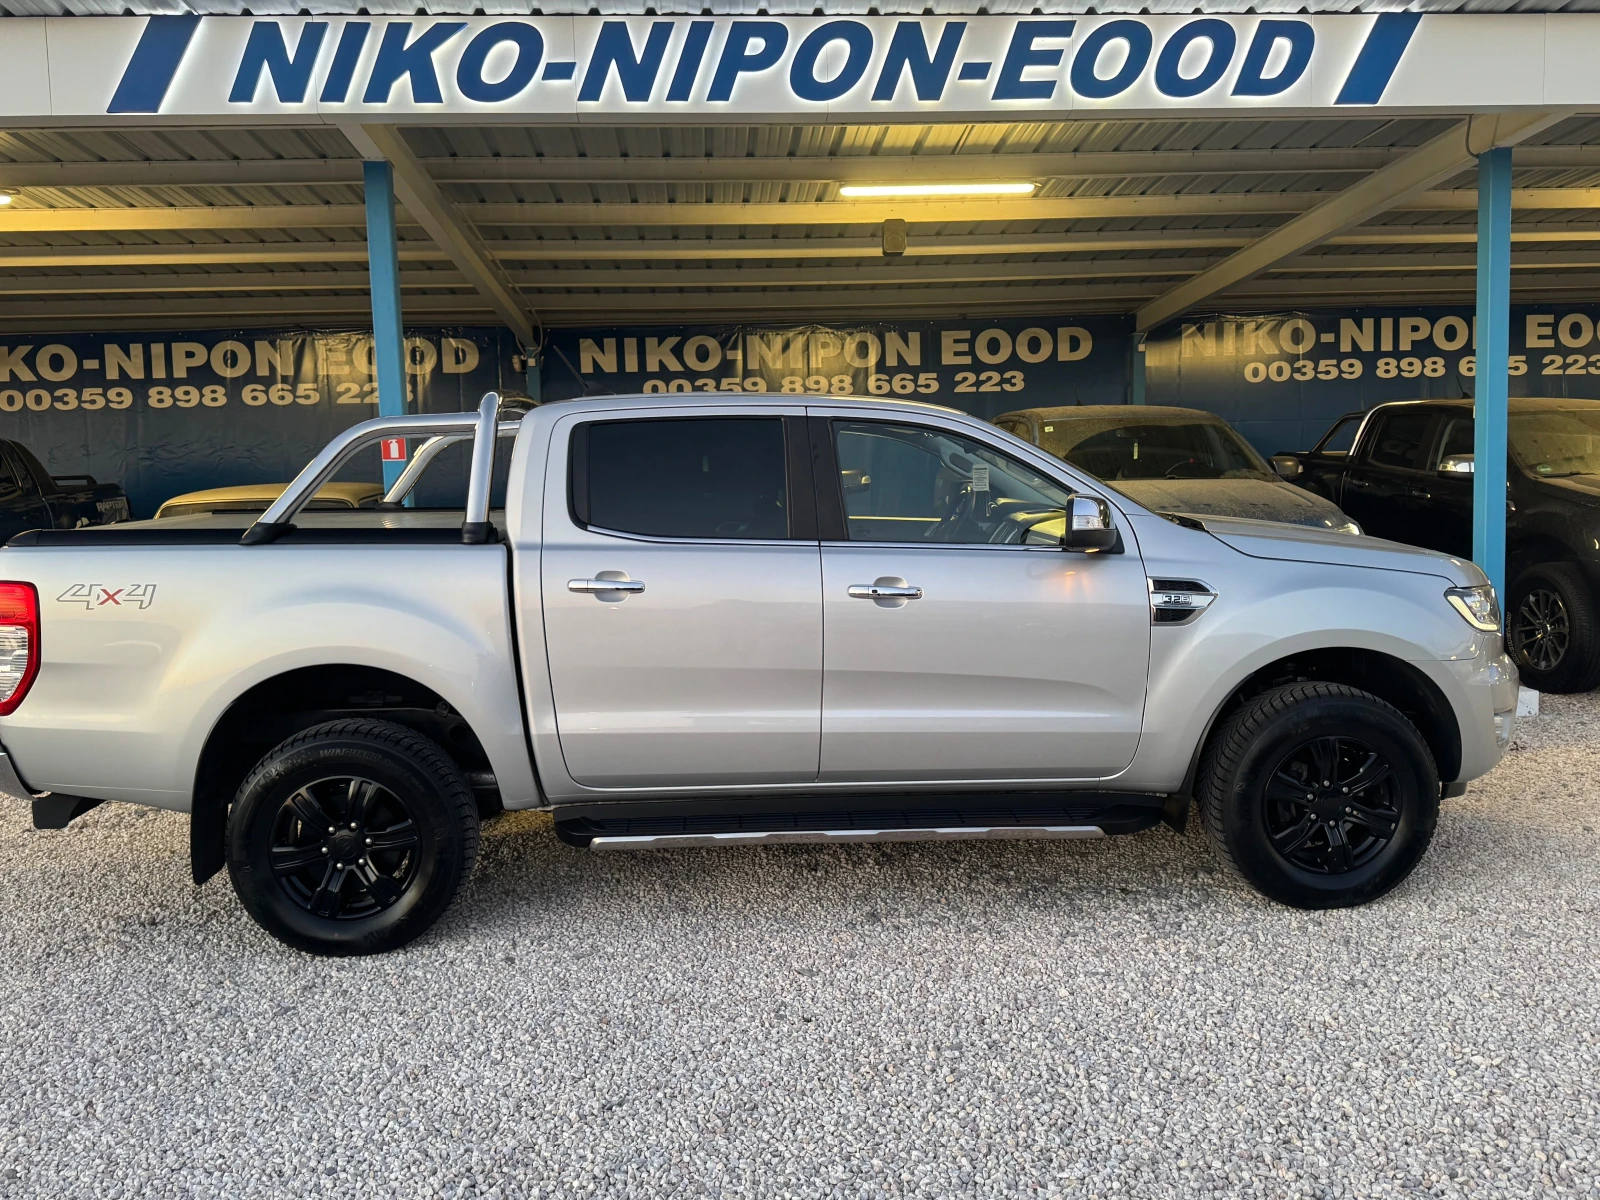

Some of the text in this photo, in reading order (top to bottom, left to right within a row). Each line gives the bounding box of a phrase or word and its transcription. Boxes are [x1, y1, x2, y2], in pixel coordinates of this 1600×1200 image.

[228, 18, 1315, 104] NIKO-NIPON-EOOD
[579, 327, 1093, 374] NIKO-NIPON EOOD
[1181, 313, 1600, 358] NIKO-NIPO EO
[781, 375, 854, 395] 898
[867, 373, 939, 394] 665
[954, 371, 1025, 393] 223
[1244, 358, 1363, 383] 00359
[1375, 356, 1446, 379] 898
[1458, 355, 1528, 377] 65
[0, 382, 414, 412] 00359 898 665 22
[95, 499, 128, 512] RAPTOR
